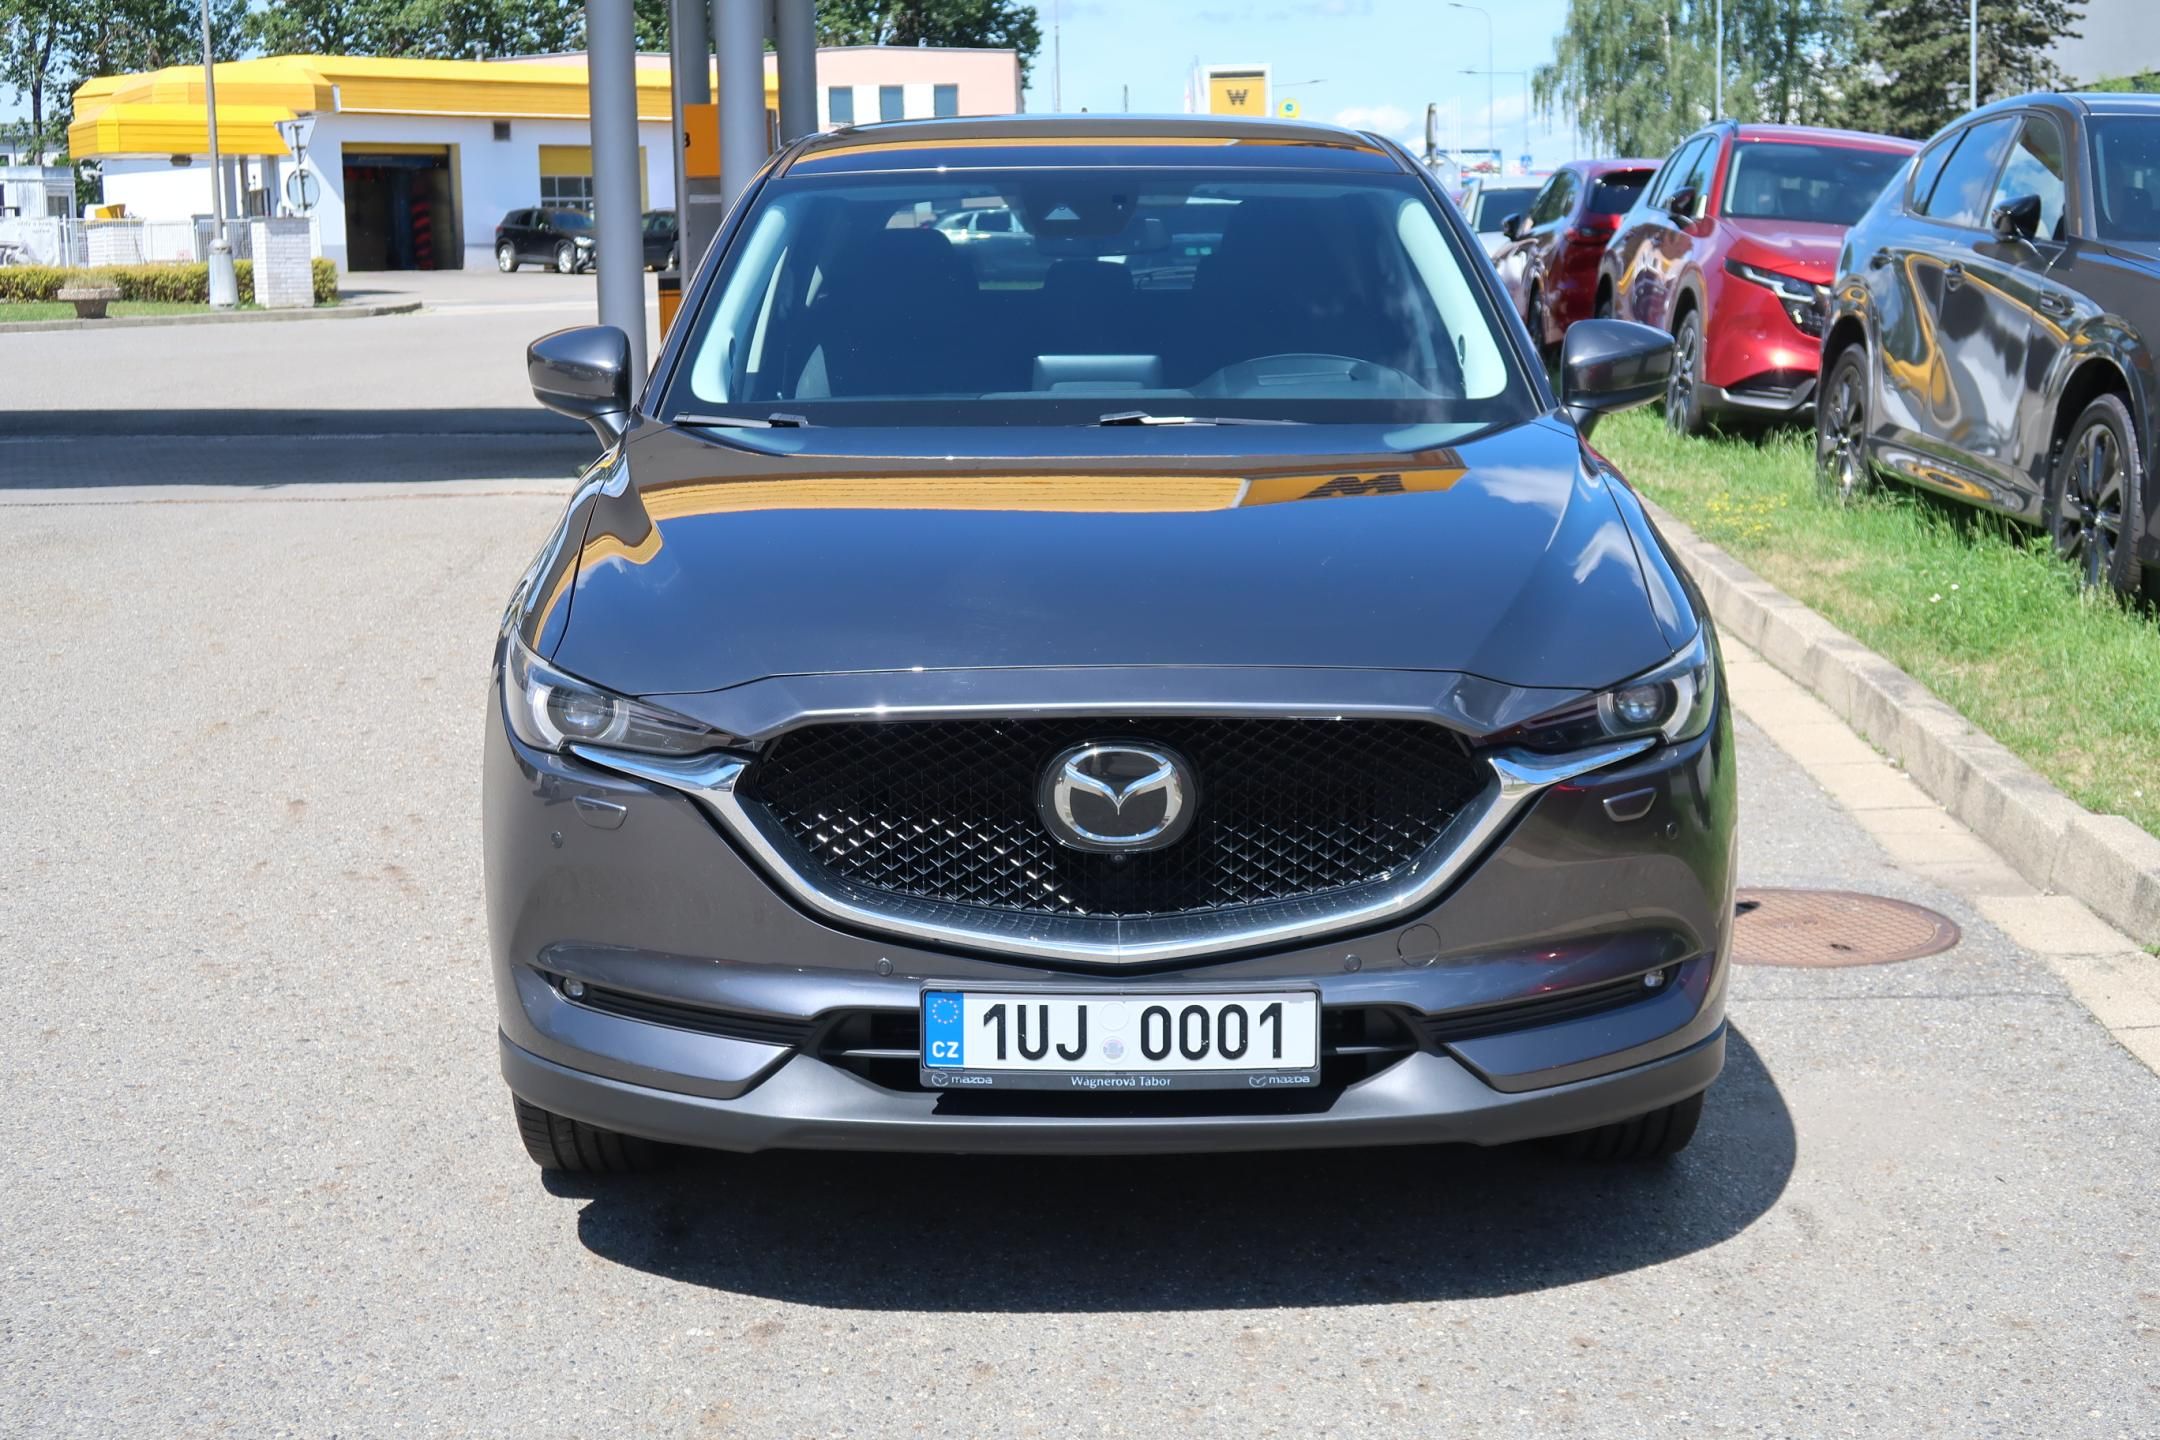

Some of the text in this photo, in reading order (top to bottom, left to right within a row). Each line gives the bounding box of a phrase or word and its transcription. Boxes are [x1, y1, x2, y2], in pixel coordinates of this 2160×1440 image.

[1226, 88, 1249, 105] W
[983, 1002, 1283, 1061] 1UJ 0001
[932, 1041, 959, 1058] CZ
[951, 1075, 993, 1085] mazda
[1268, 1075, 1311, 1084] mazda
